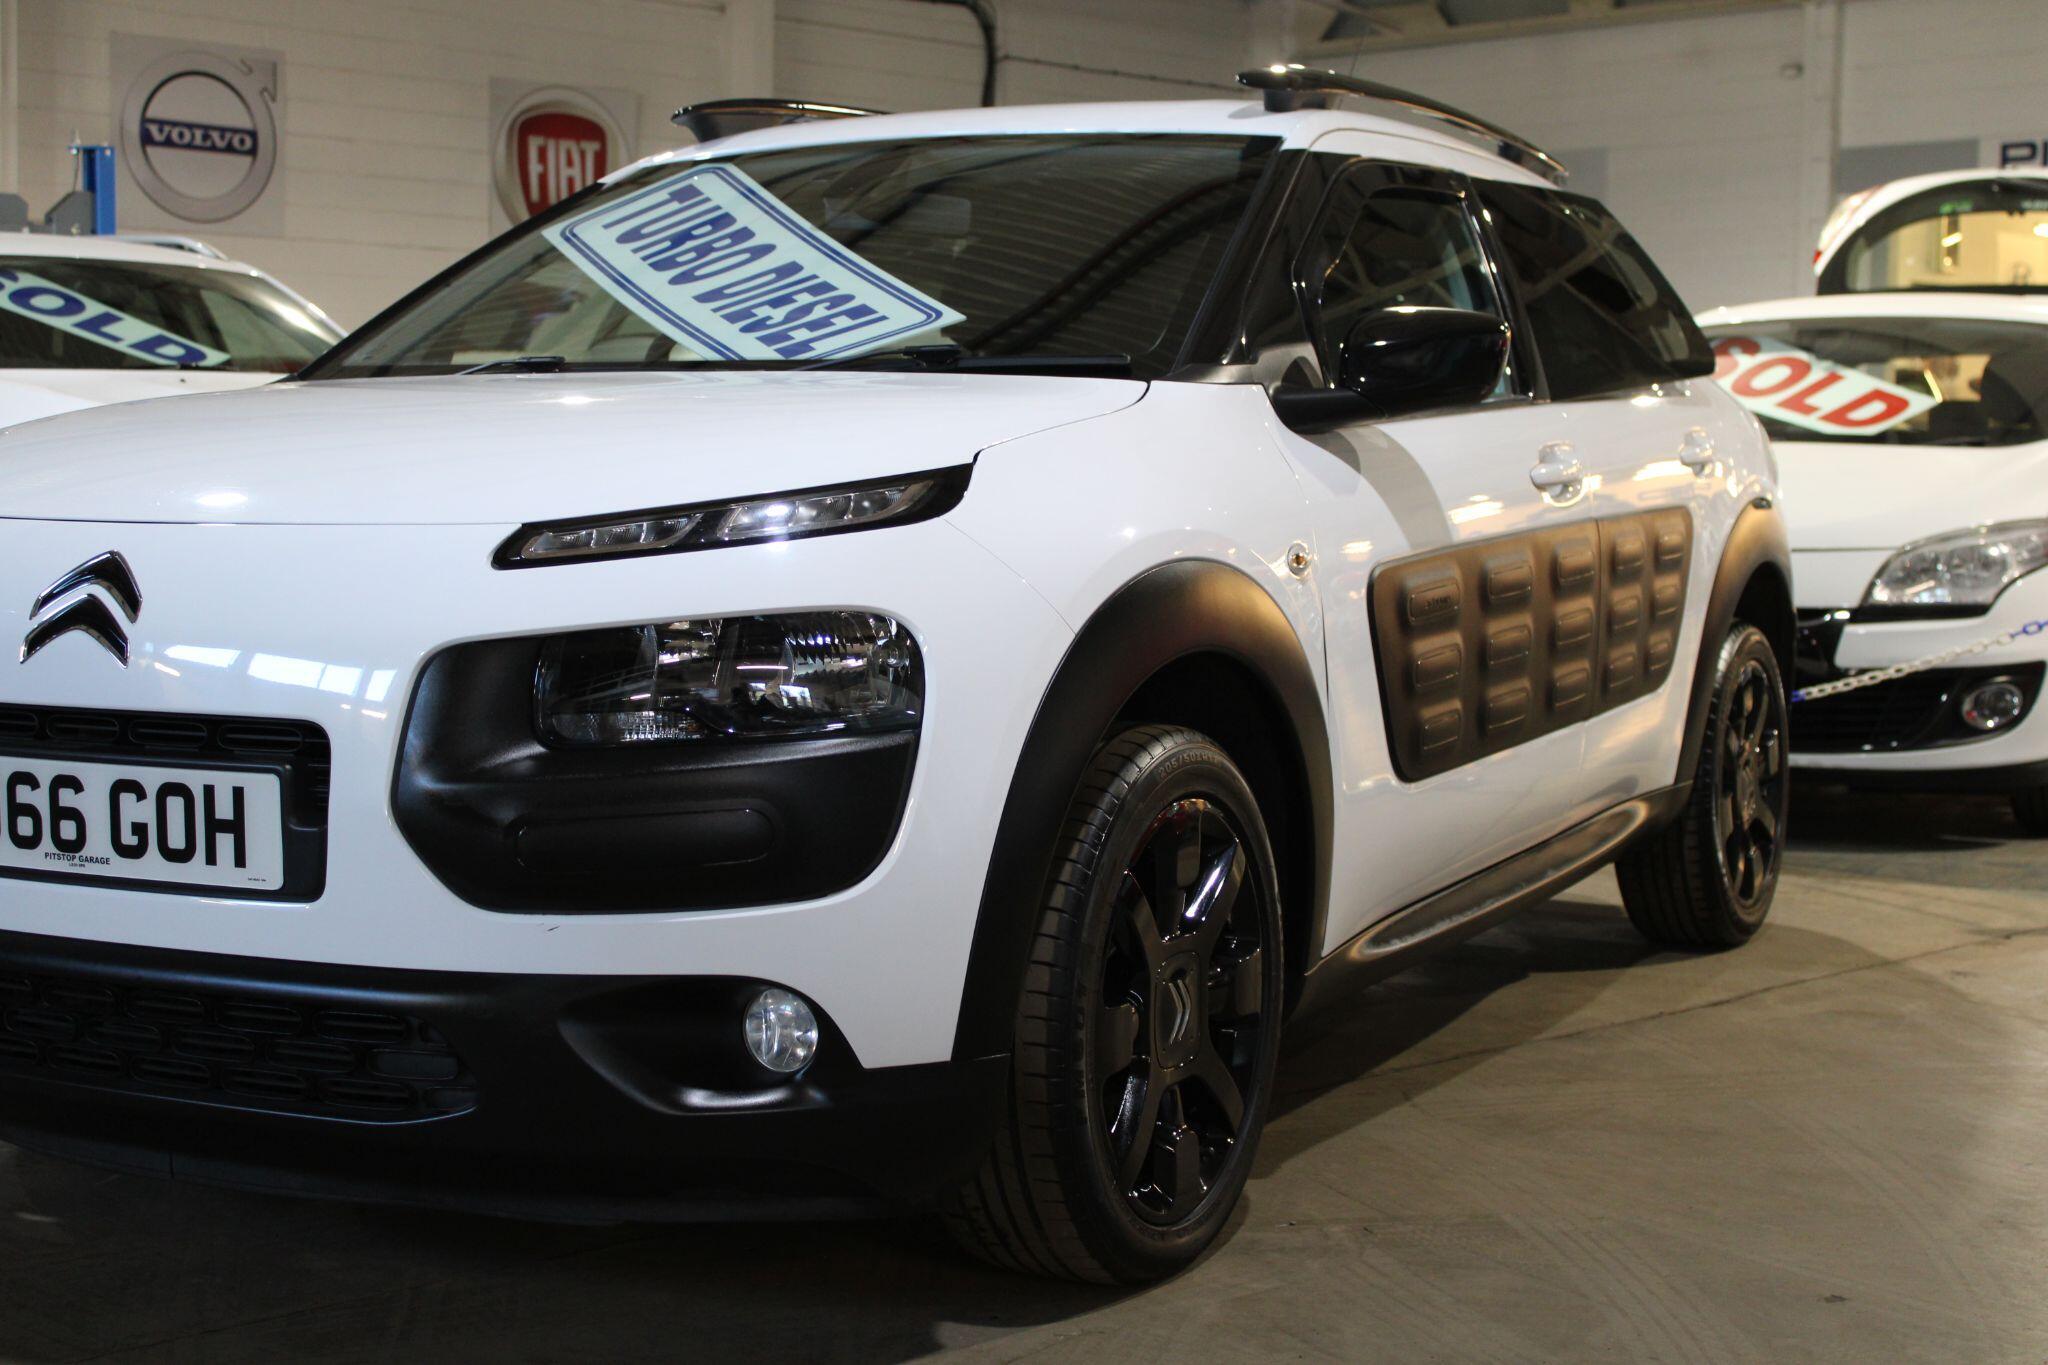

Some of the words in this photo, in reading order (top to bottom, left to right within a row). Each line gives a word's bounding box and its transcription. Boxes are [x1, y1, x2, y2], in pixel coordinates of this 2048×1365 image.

[145, 122, 254, 151] VOLVO
[527, 135, 601, 204] FIAT
[2002, 141, 2048, 169] P
[601, 183, 777, 286] TURBO
[691, 260, 890, 360] DIESEL
[1711, 337, 1910, 428] SOLD
[0, 770, 87, 854] 66
[109, 778, 247, 869] GOH
[44, 852, 77, 862] PITSTOP
[78, 855, 111, 865] GARAGE
